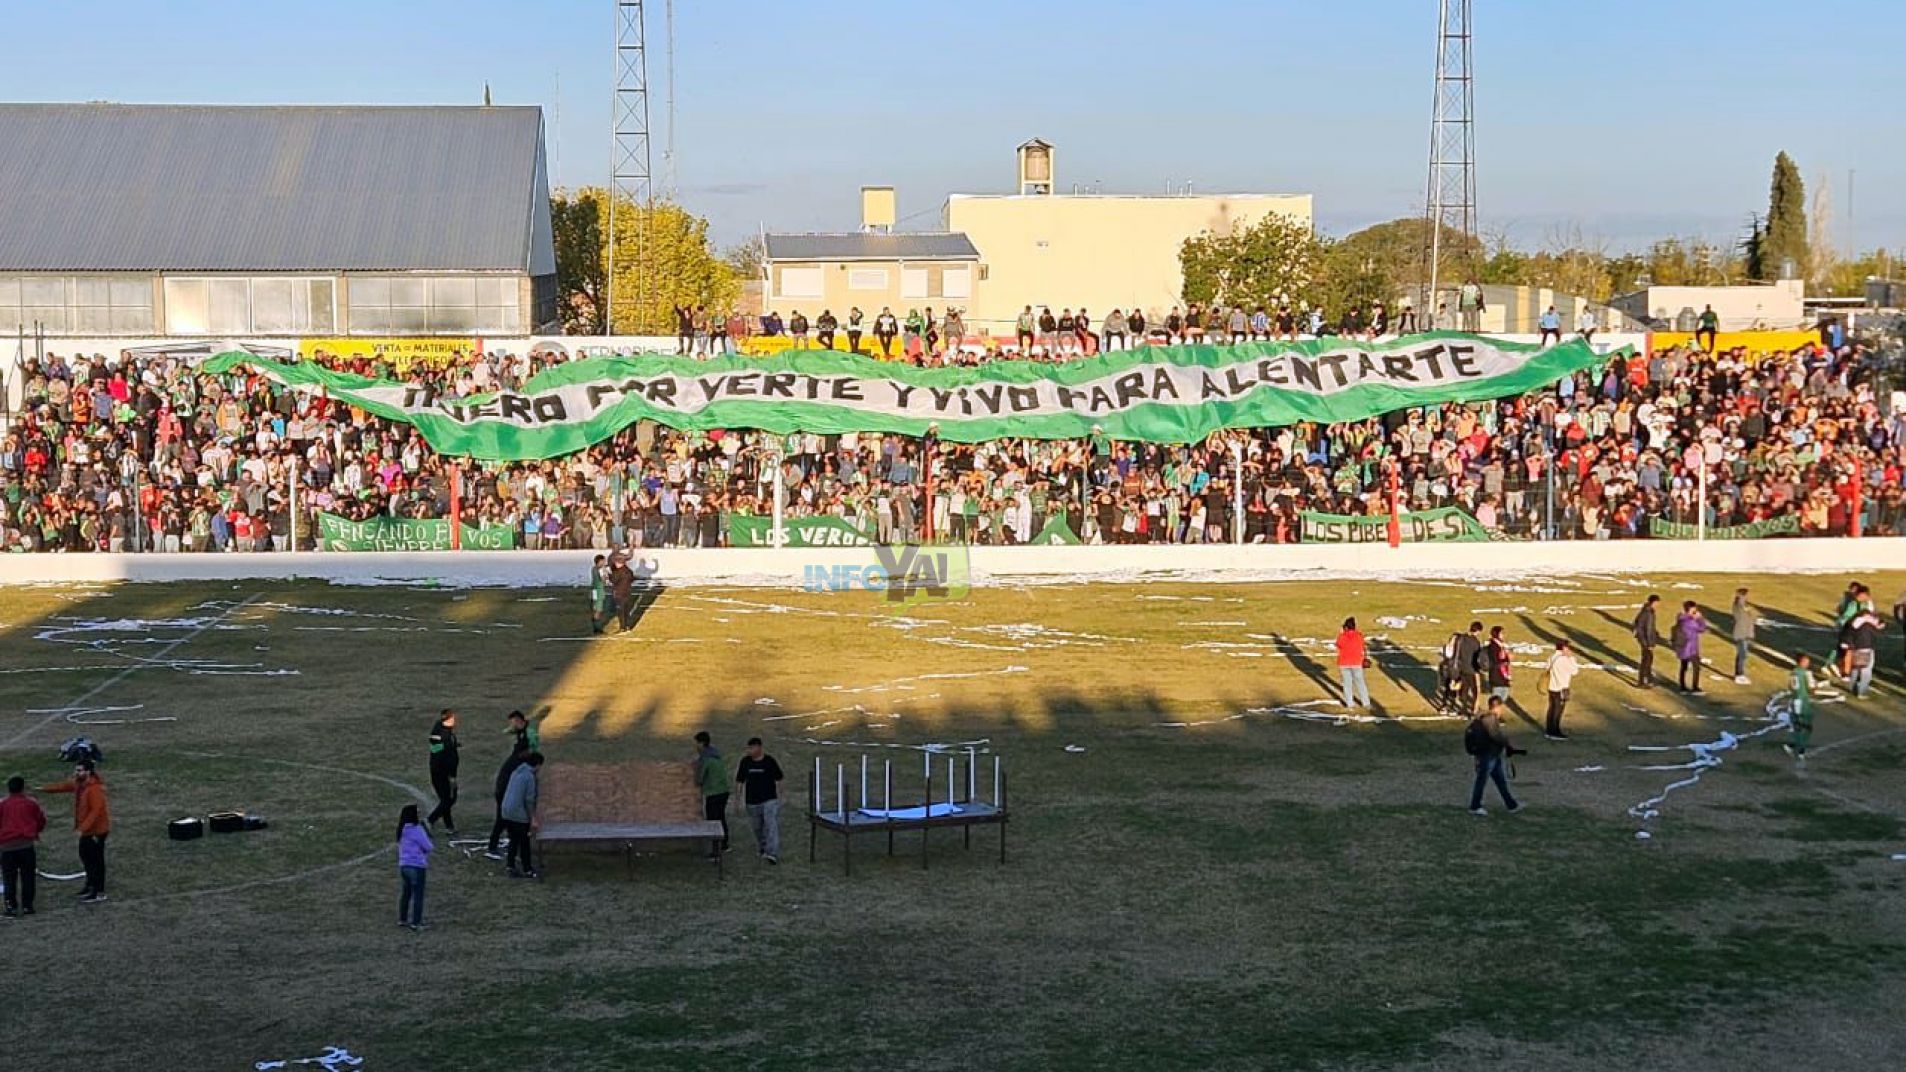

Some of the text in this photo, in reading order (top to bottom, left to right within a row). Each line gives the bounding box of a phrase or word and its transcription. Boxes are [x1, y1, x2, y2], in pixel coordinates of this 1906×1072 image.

[698, 373, 864, 401] VERTE
[889, 381, 917, 408] Y
[1200, 345, 1482, 400] ALENTARTE
[467, 530, 503, 548] VOS
[1302, 513, 1344, 542] LOS
[1347, 521, 1389, 543] PIBE
[1411, 516, 1437, 542] DE
